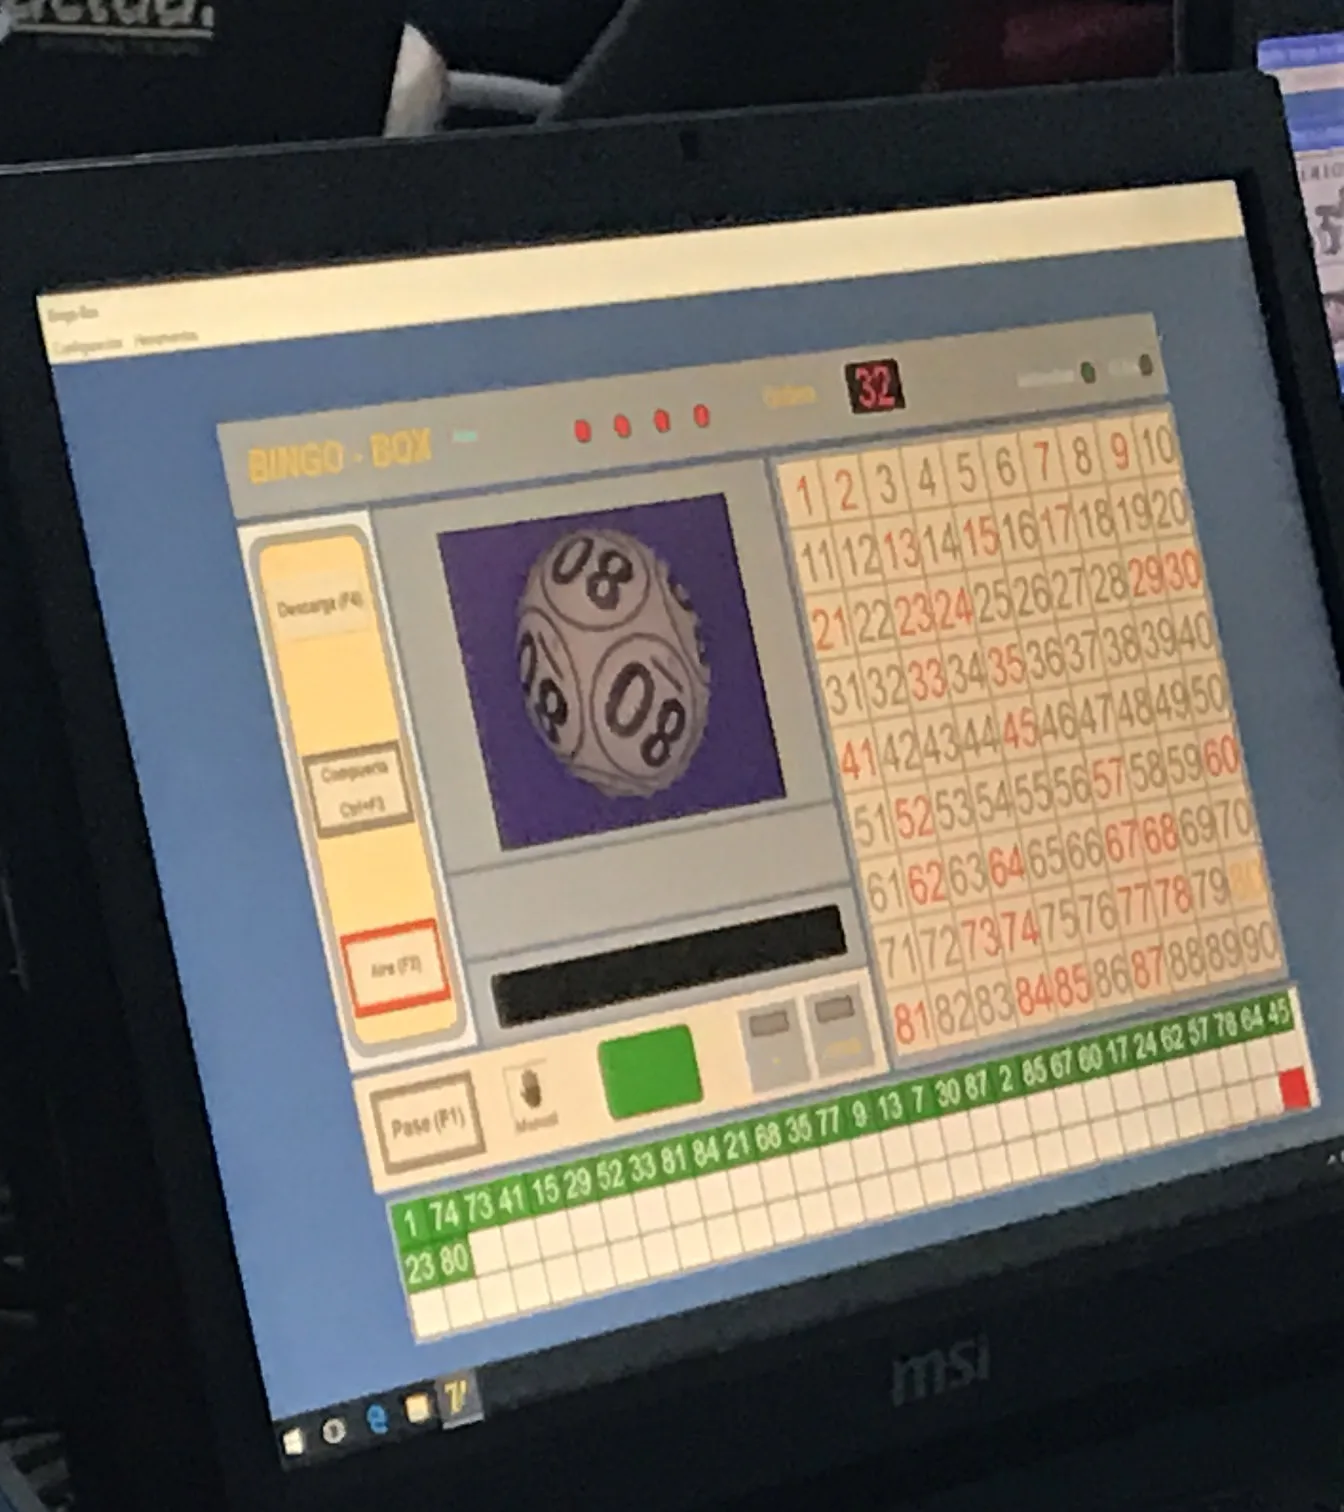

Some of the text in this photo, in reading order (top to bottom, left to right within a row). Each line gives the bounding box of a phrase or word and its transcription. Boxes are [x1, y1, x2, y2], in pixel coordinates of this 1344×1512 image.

[855, 366, 896, 408] 32
[247, 440, 344, 485] BINGO
[958, 425, 1173, 493] 5 7 10
[964, 515, 1001, 558] 15
[909, 657, 1238, 779] 33 60
[895, 845, 1024, 1045] 64 81
[429, 1200, 461, 1231] 74
[1134, 1030, 1158, 1057] 24
[404, 1244, 468, 1284] 23 80
[892, 1334, 989, 1407] msi
